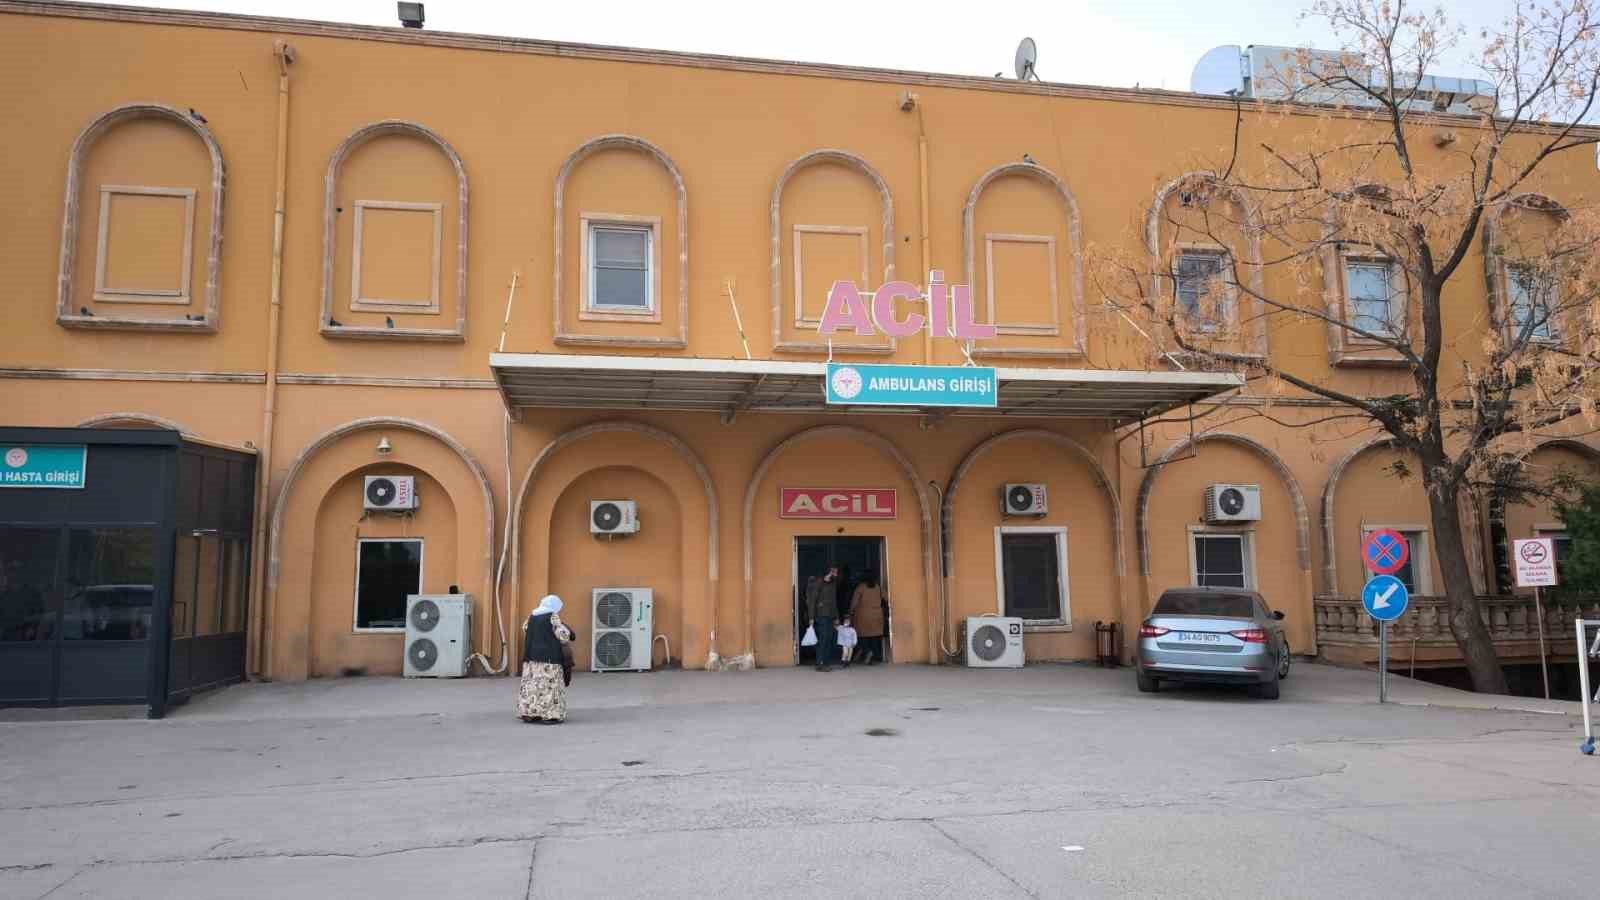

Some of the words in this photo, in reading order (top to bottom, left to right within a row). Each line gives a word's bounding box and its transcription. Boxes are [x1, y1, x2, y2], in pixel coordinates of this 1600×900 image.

[817, 270, 997, 340] ACİL
[869, 376, 945, 393] AMBULANS
[949, 376, 992, 396] GİRİŞİ
[5, 471, 42, 482] HASTA
[45, 470, 81, 484] GİRİŞİ
